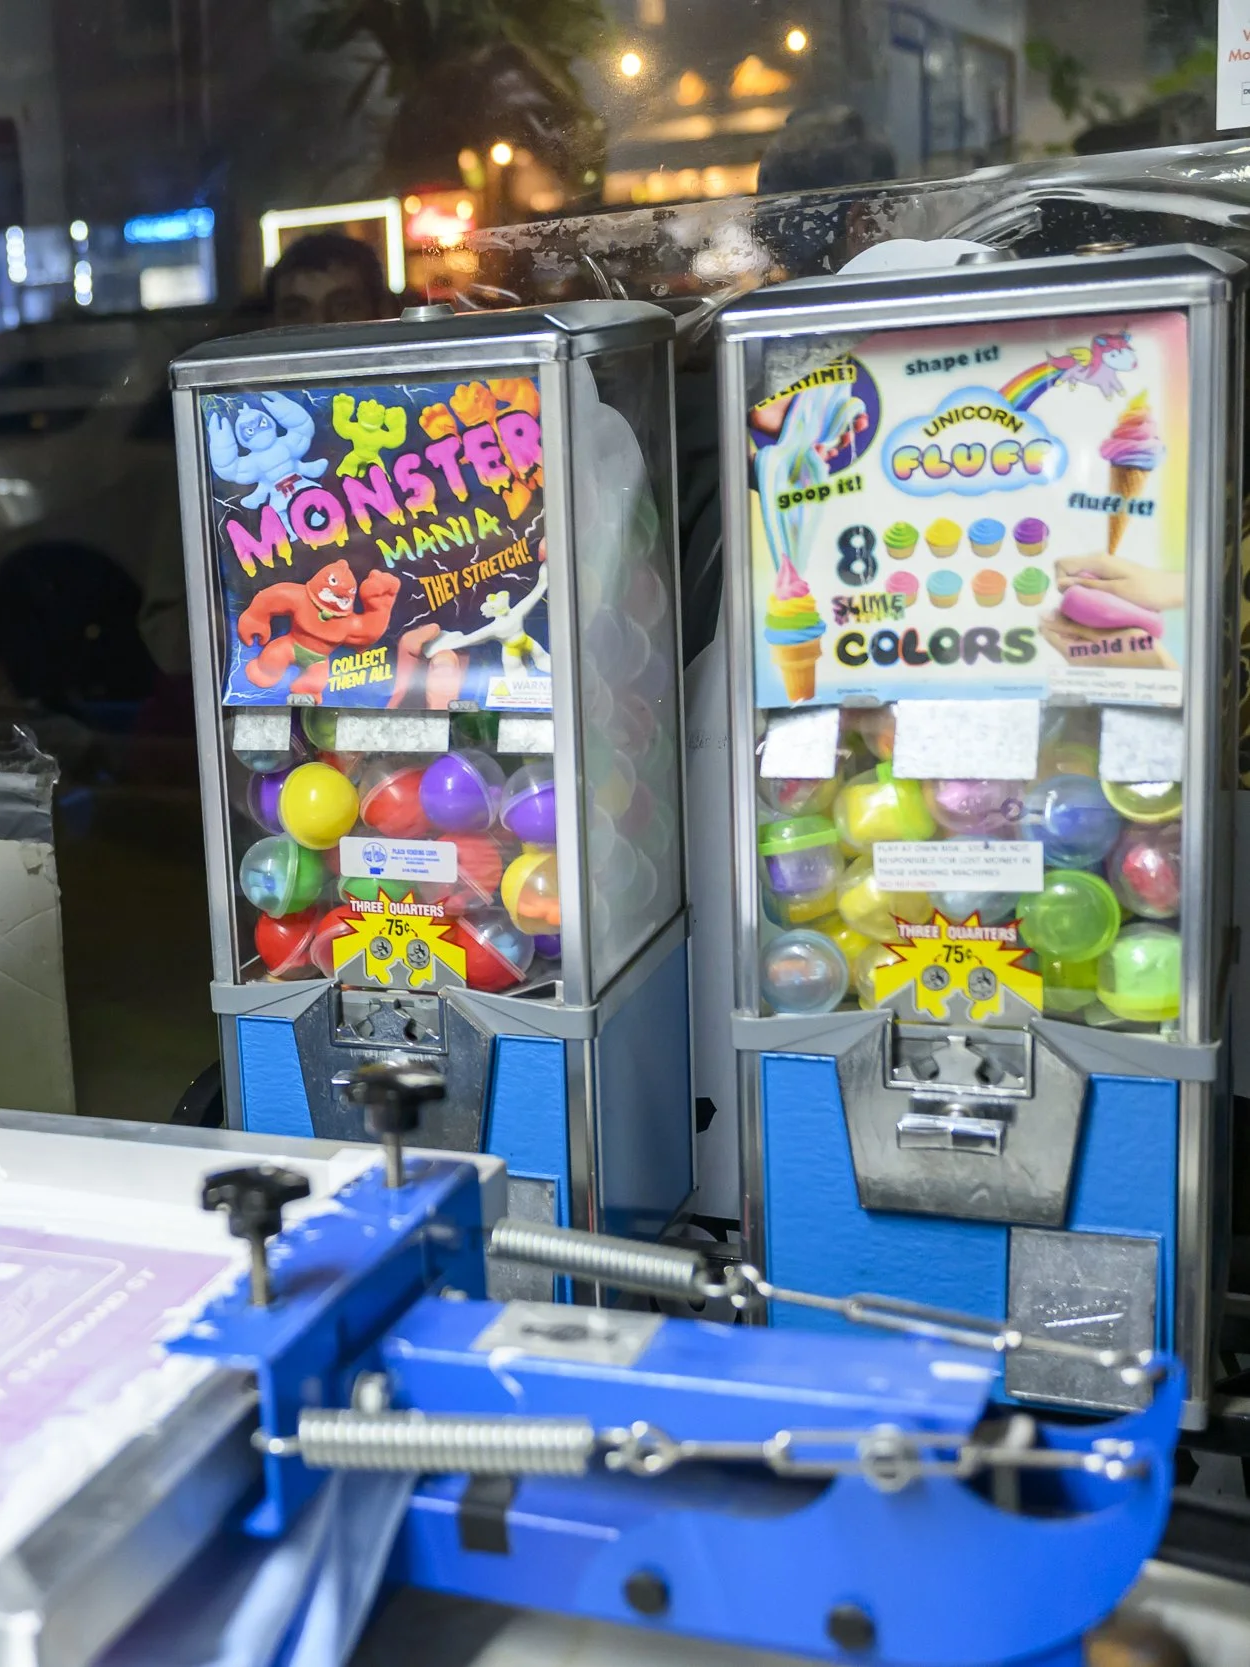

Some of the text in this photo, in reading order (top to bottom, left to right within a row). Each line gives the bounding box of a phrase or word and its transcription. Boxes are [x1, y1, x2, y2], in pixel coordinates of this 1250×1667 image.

[905, 346, 1000, 376] shape it!
[923, 405, 1024, 437] UNICORN
[226, 411, 543, 577] MONSTER
[778, 476, 863, 511] goop it!
[1069, 493, 1155, 516] fluff it!
[375, 507, 503, 569] MANIA
[837, 524, 878, 587] 8
[419, 537, 534, 612] THEY STRETCH!
[832, 594, 906, 623] SLIME
[835, 627, 1038, 667] COLORS
[1069, 635, 1154, 657] mold it!
[331, 647, 388, 675] COLLECT
[328, 664, 393, 692] THEM ALL
[350, 900, 445, 917] THREE QUARTERS
[385, 918, 410, 936] 75¢
[897, 924, 1017, 942] THREE QUARTERS
[942, 944, 972, 964] 75¢
